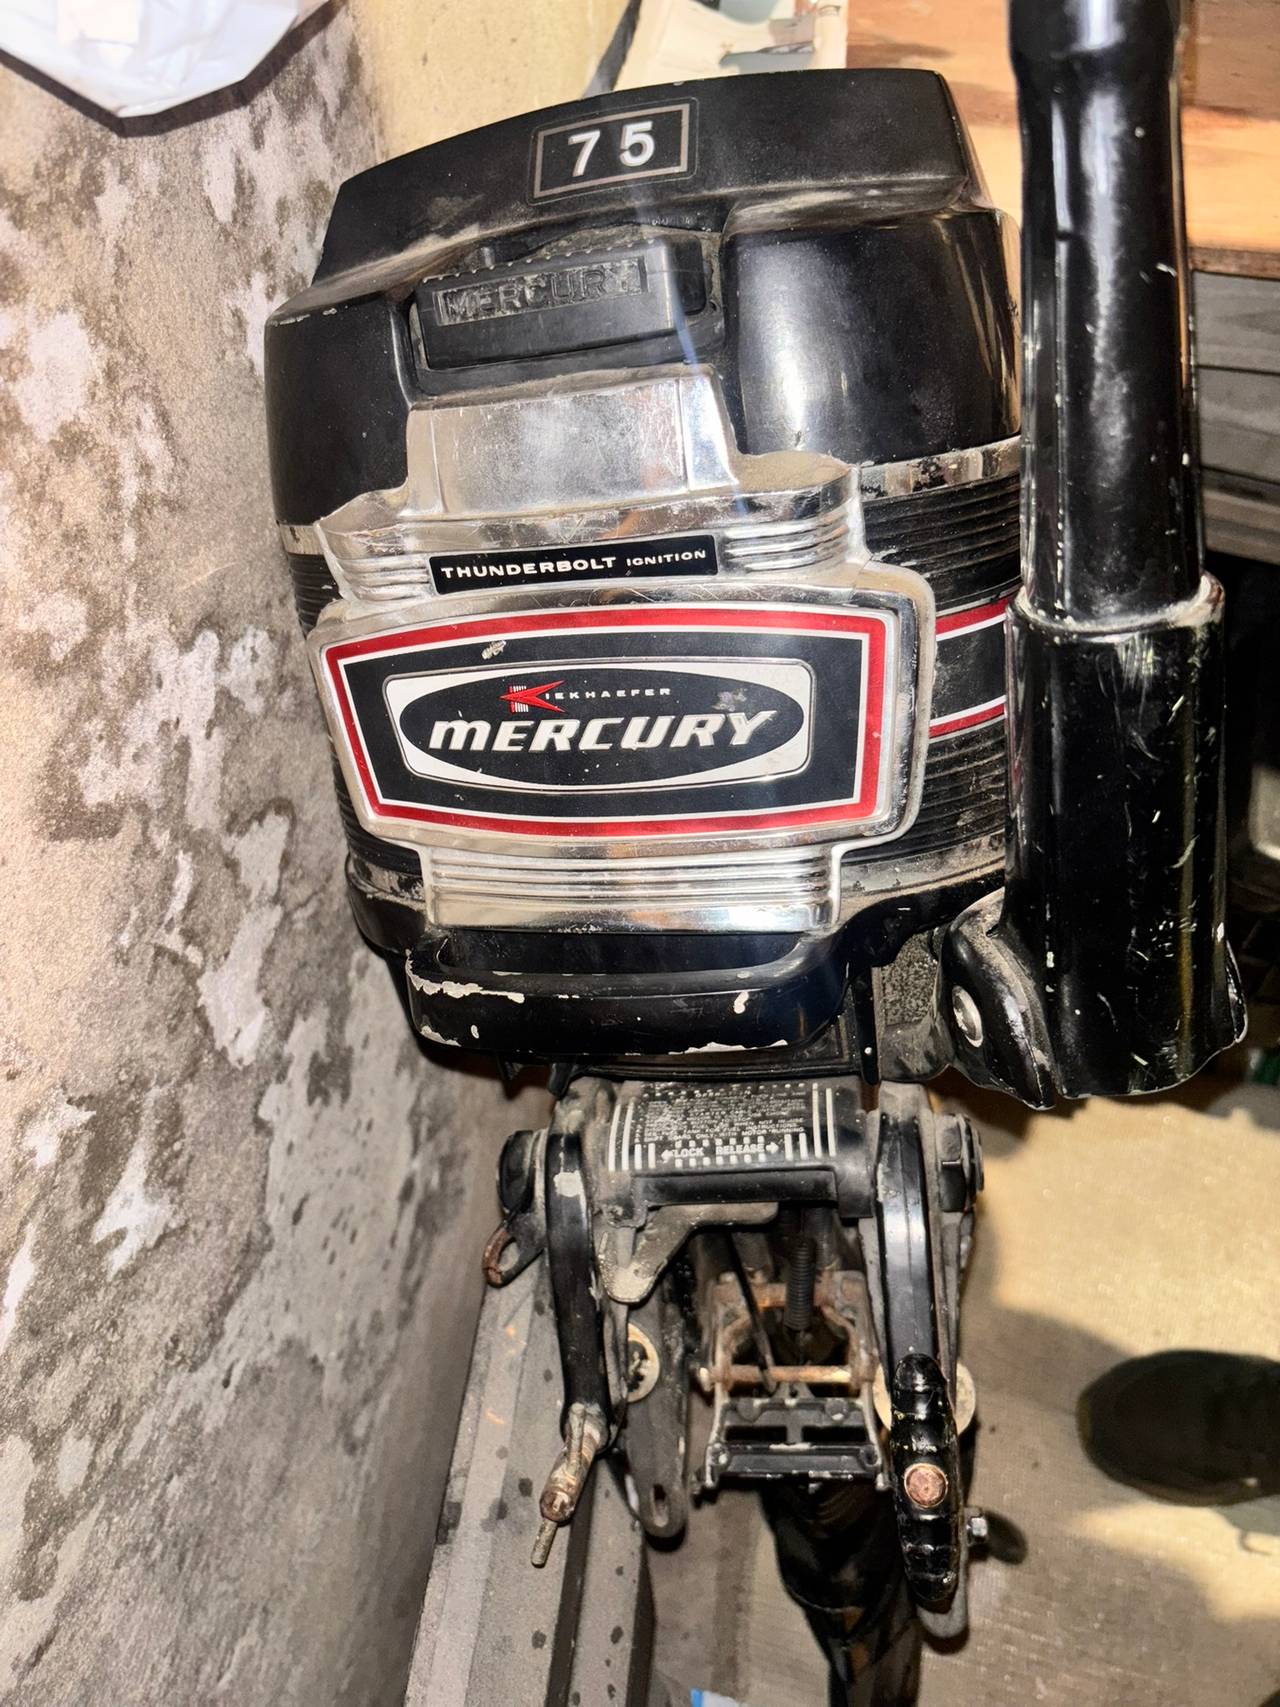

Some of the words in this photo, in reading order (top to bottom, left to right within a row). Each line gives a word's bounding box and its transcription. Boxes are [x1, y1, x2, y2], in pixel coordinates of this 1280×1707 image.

[568, 120, 655, 177] 75
[441, 262, 641, 321] MERCURY
[441, 556, 616, 579] THUNDERBOLT
[626, 549, 707, 568] IGNITION
[428, 711, 777, 752] MERCURY
[674, 1147, 705, 1158] LOCK
[715, 1143, 765, 1156] RELEASE
